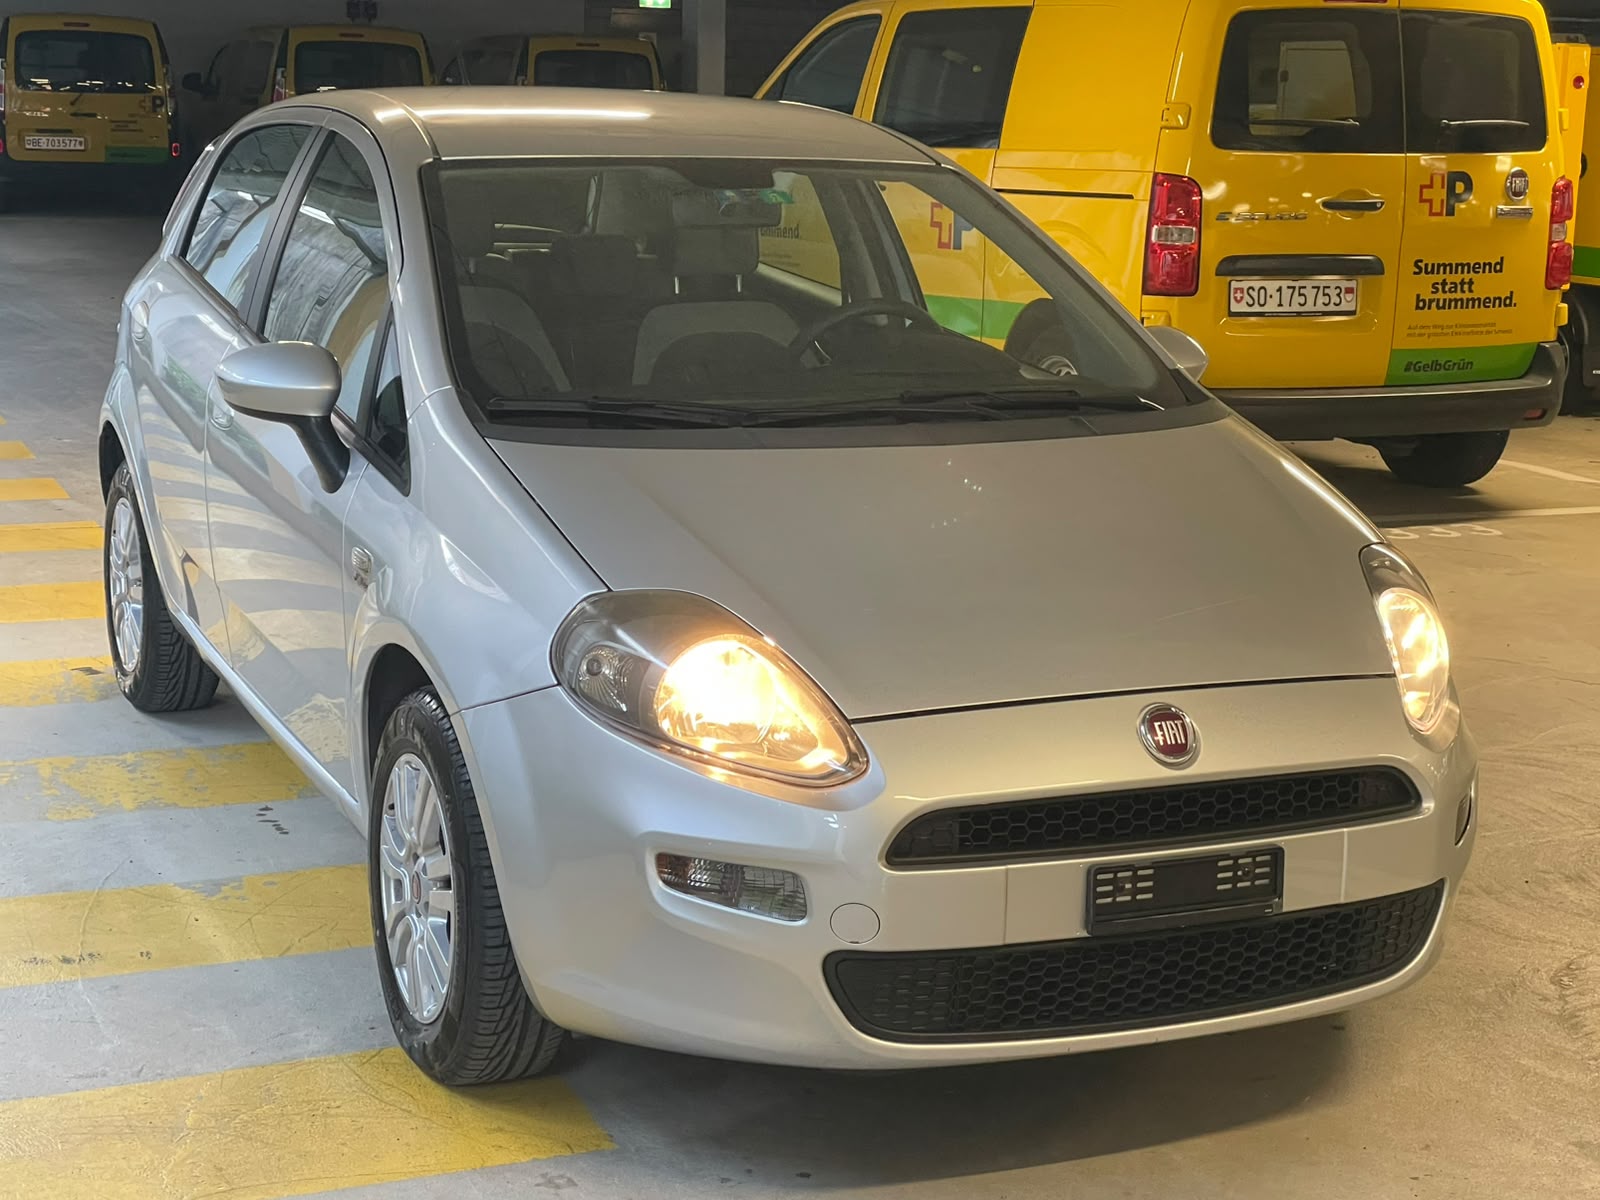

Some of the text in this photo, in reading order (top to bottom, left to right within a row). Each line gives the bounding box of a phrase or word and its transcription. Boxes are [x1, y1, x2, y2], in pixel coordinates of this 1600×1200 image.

[1445, 171, 1474, 217] P
[1413, 256, 1504, 276] Summend
[1431, 277, 1475, 295] statt
[1414, 290, 1518, 312] brummend.
[1403, 358, 1474, 373] #GelbGrün
[1153, 720, 1186, 746] FIAT
